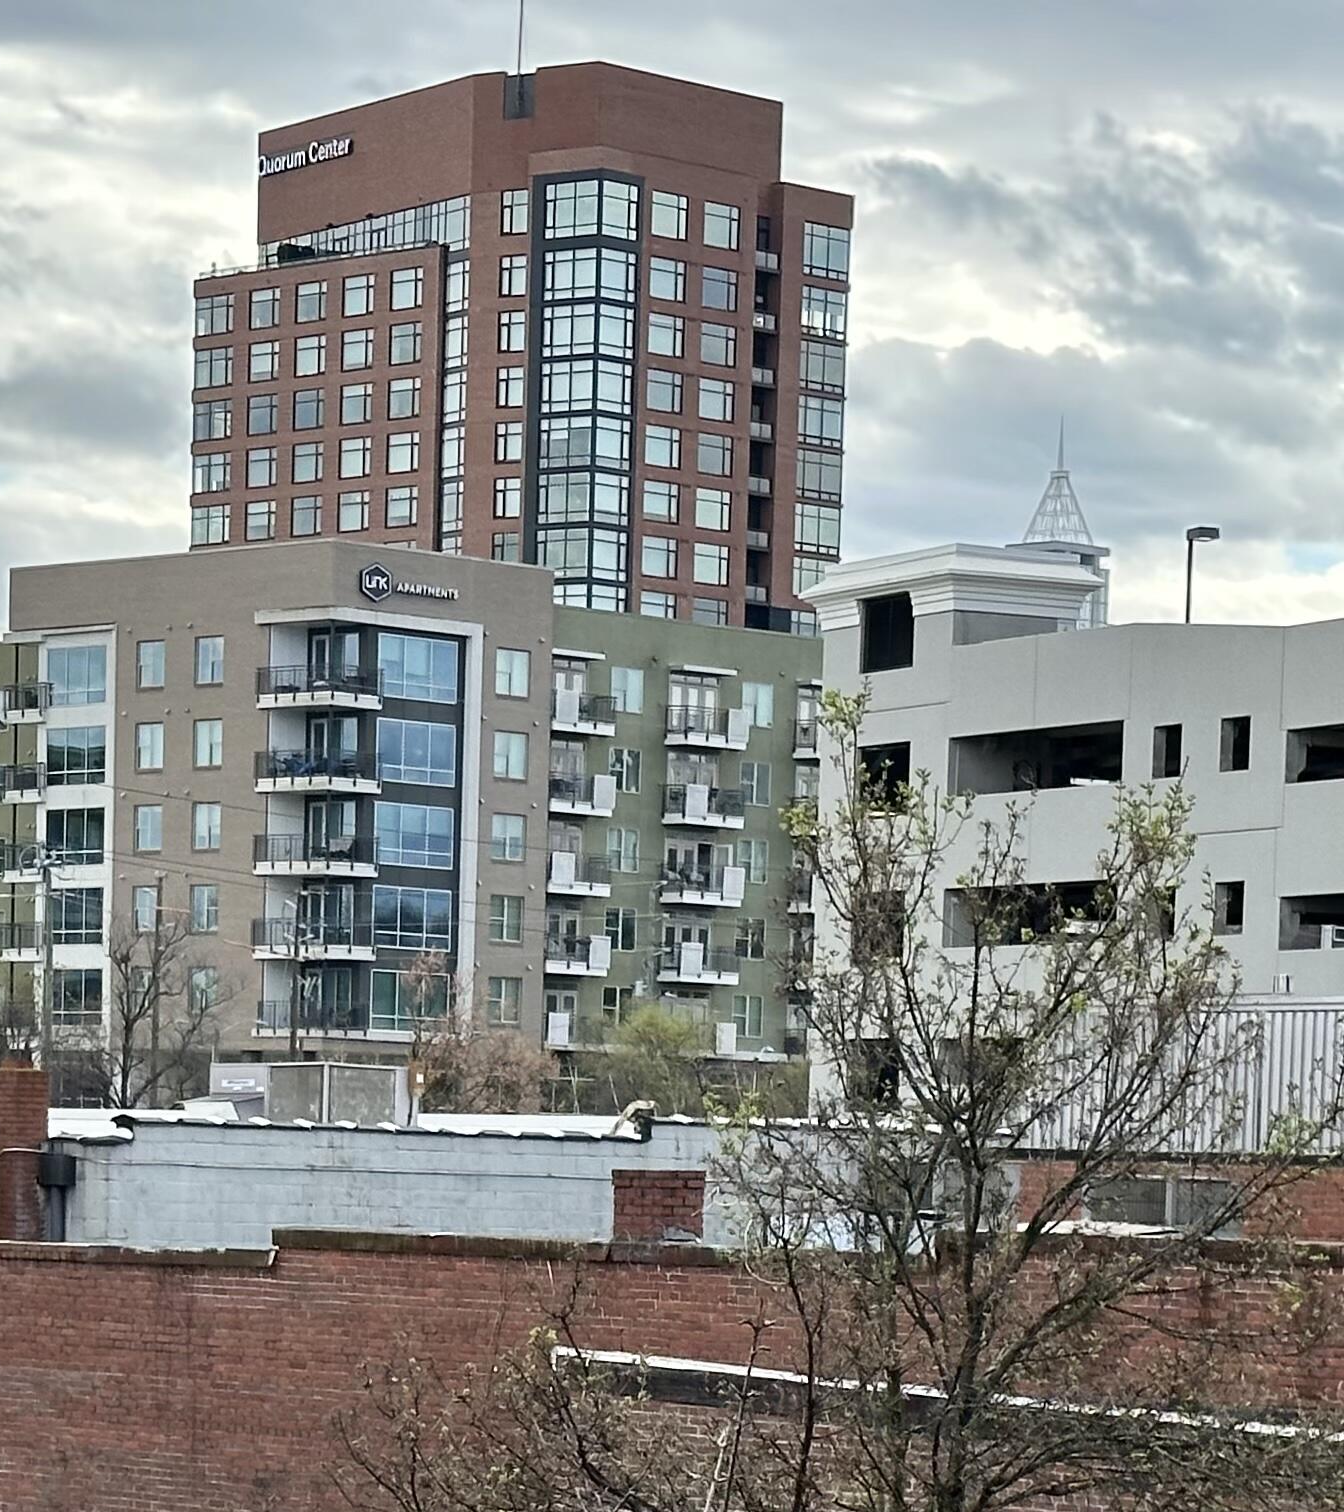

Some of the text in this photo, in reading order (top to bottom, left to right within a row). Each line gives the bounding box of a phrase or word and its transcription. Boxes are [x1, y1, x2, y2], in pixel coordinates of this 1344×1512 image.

[258, 138, 351, 176] Quorum Center
[397, 582, 460, 600] APARTMENTS
